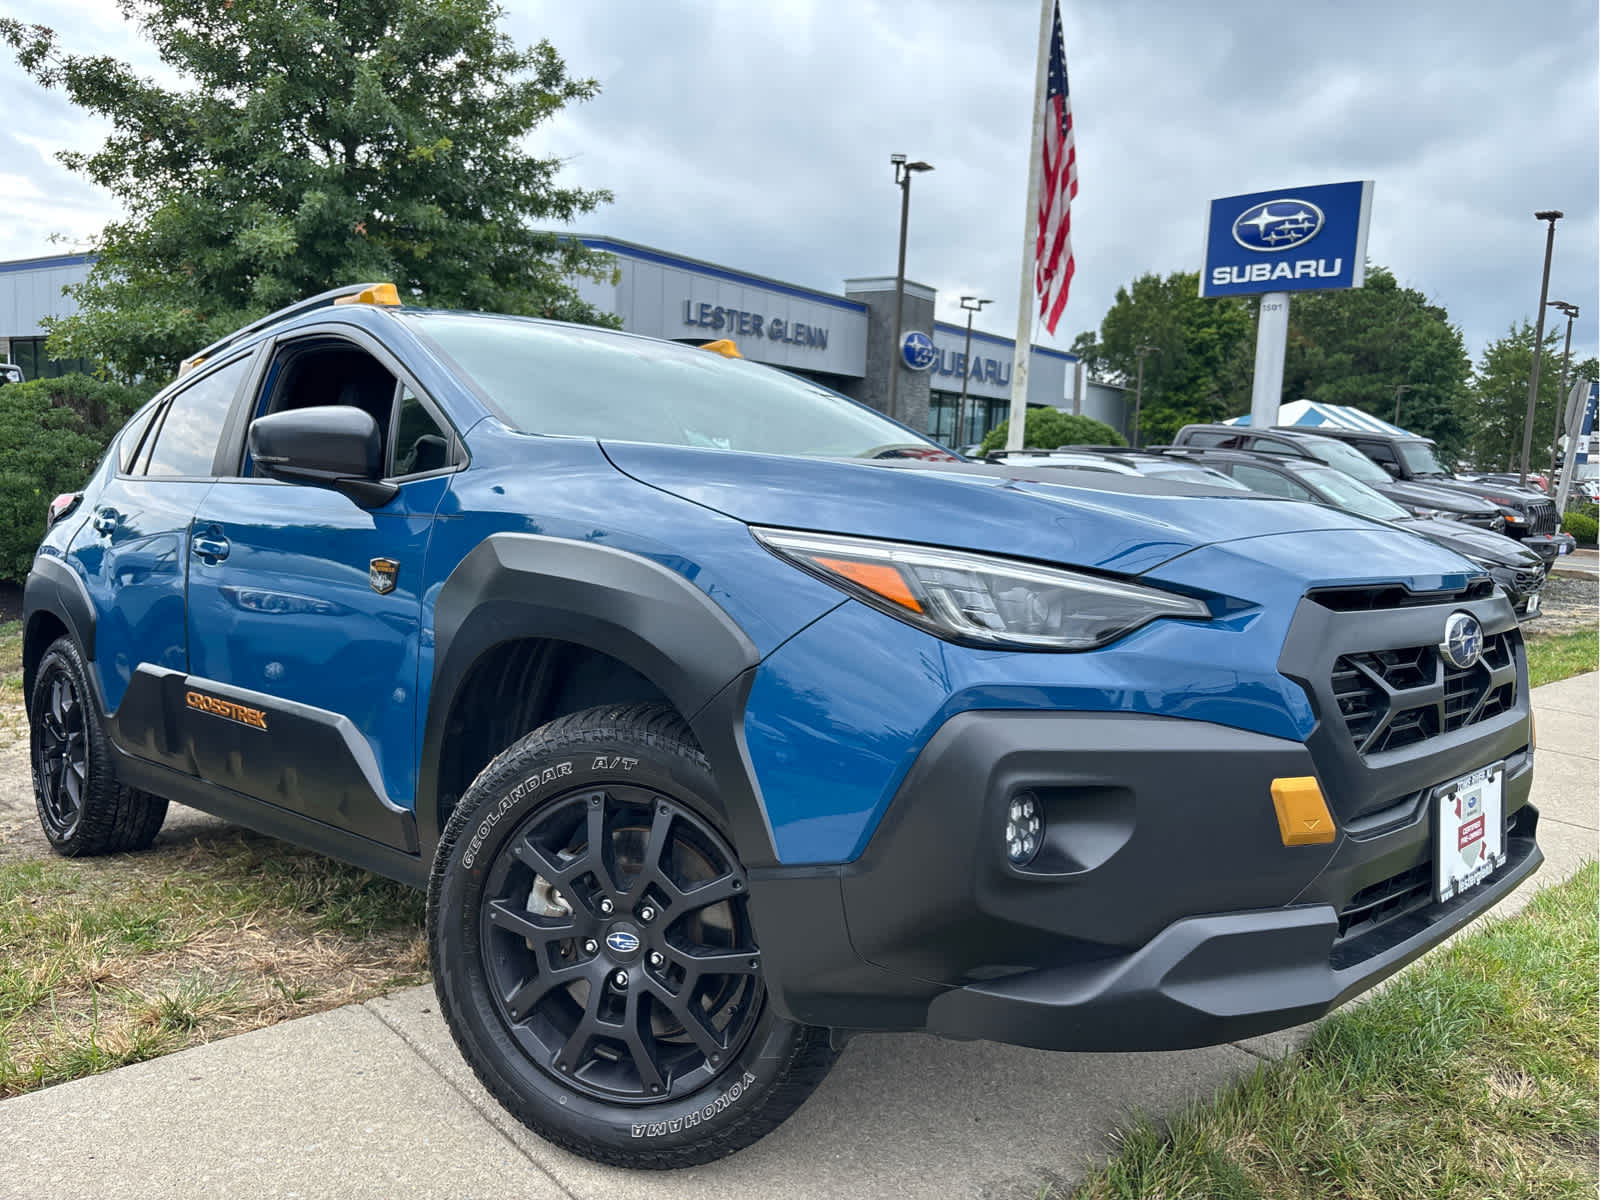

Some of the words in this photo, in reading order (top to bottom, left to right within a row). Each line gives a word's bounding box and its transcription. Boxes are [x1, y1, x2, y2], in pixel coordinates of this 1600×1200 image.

[1212, 258, 1342, 285] SUBARU
[684, 300, 763, 341] LESTER
[769, 318, 829, 350] GLENN
[931, 346, 1011, 386] SUBARU
[186, 691, 267, 729] CROSSTREK
[462, 761, 573, 869] GEOLANDAR
[592, 756, 638, 770] A/T
[632, 1071, 757, 1138] YOKOHAMA
